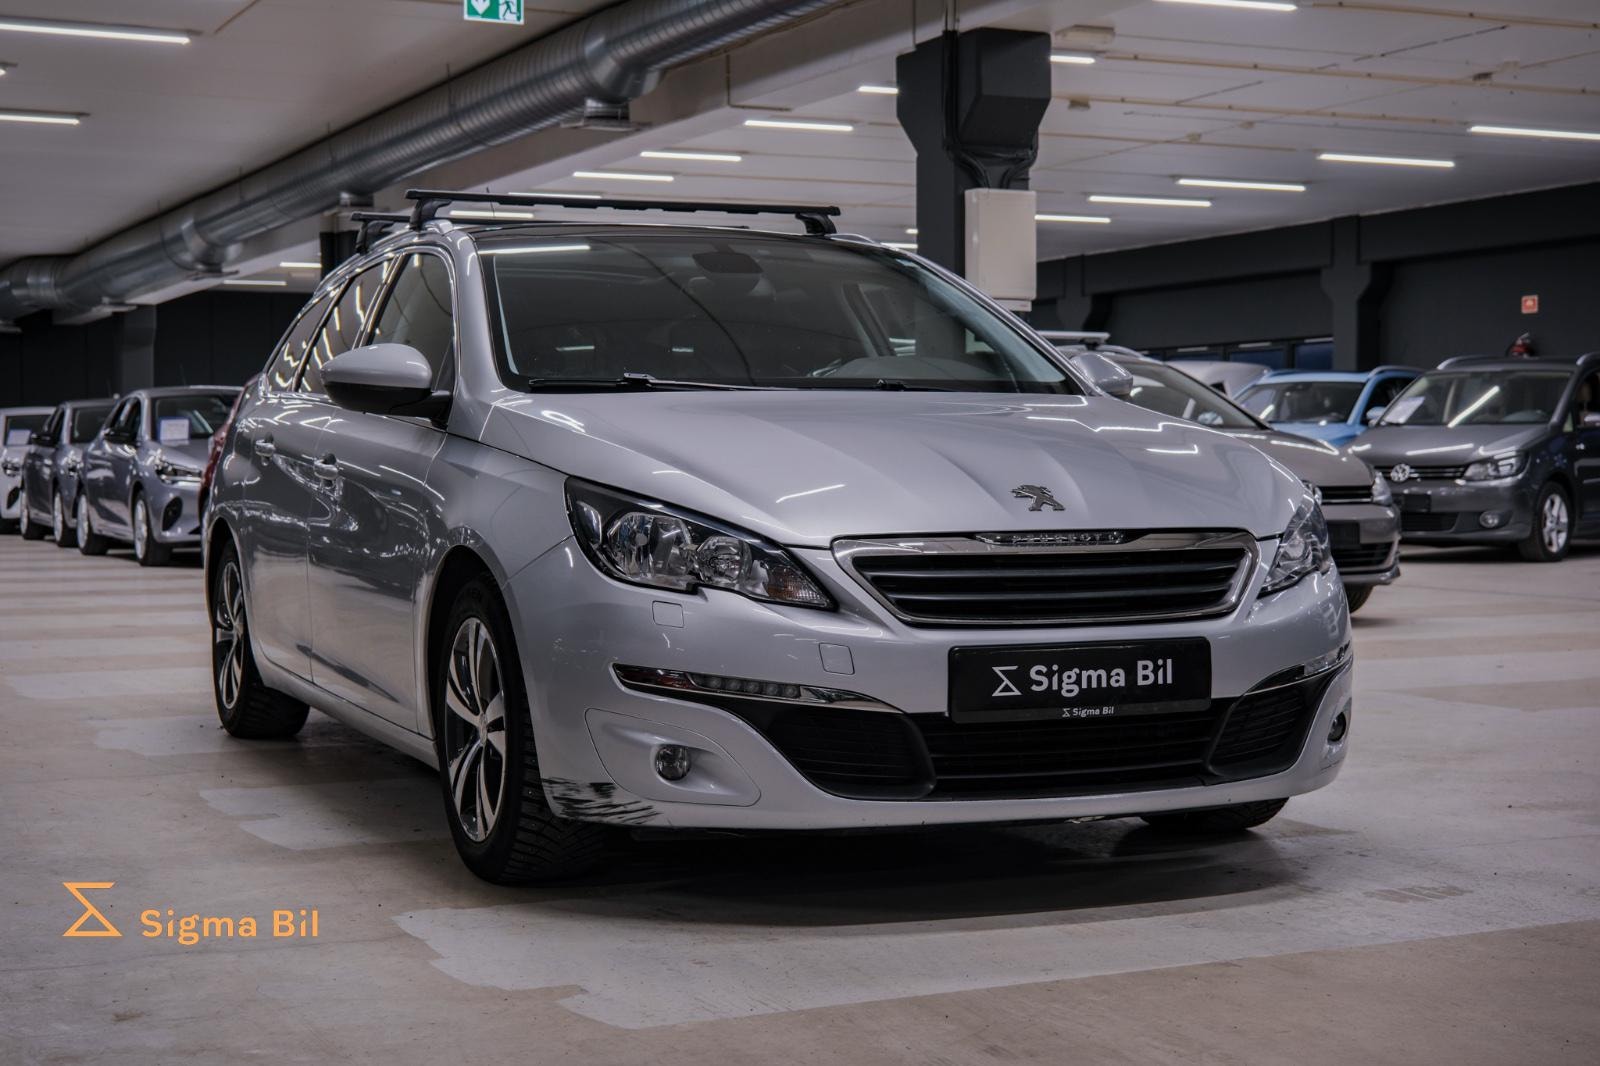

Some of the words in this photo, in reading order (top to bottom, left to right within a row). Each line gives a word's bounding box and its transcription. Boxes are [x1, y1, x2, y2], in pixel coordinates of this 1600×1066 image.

[1029, 664, 1126, 698] Sigma
[1136, 658, 1173, 686] Bil
[1072, 707, 1100, 718] Sigma
[1102, 706, 1115, 715] Bil
